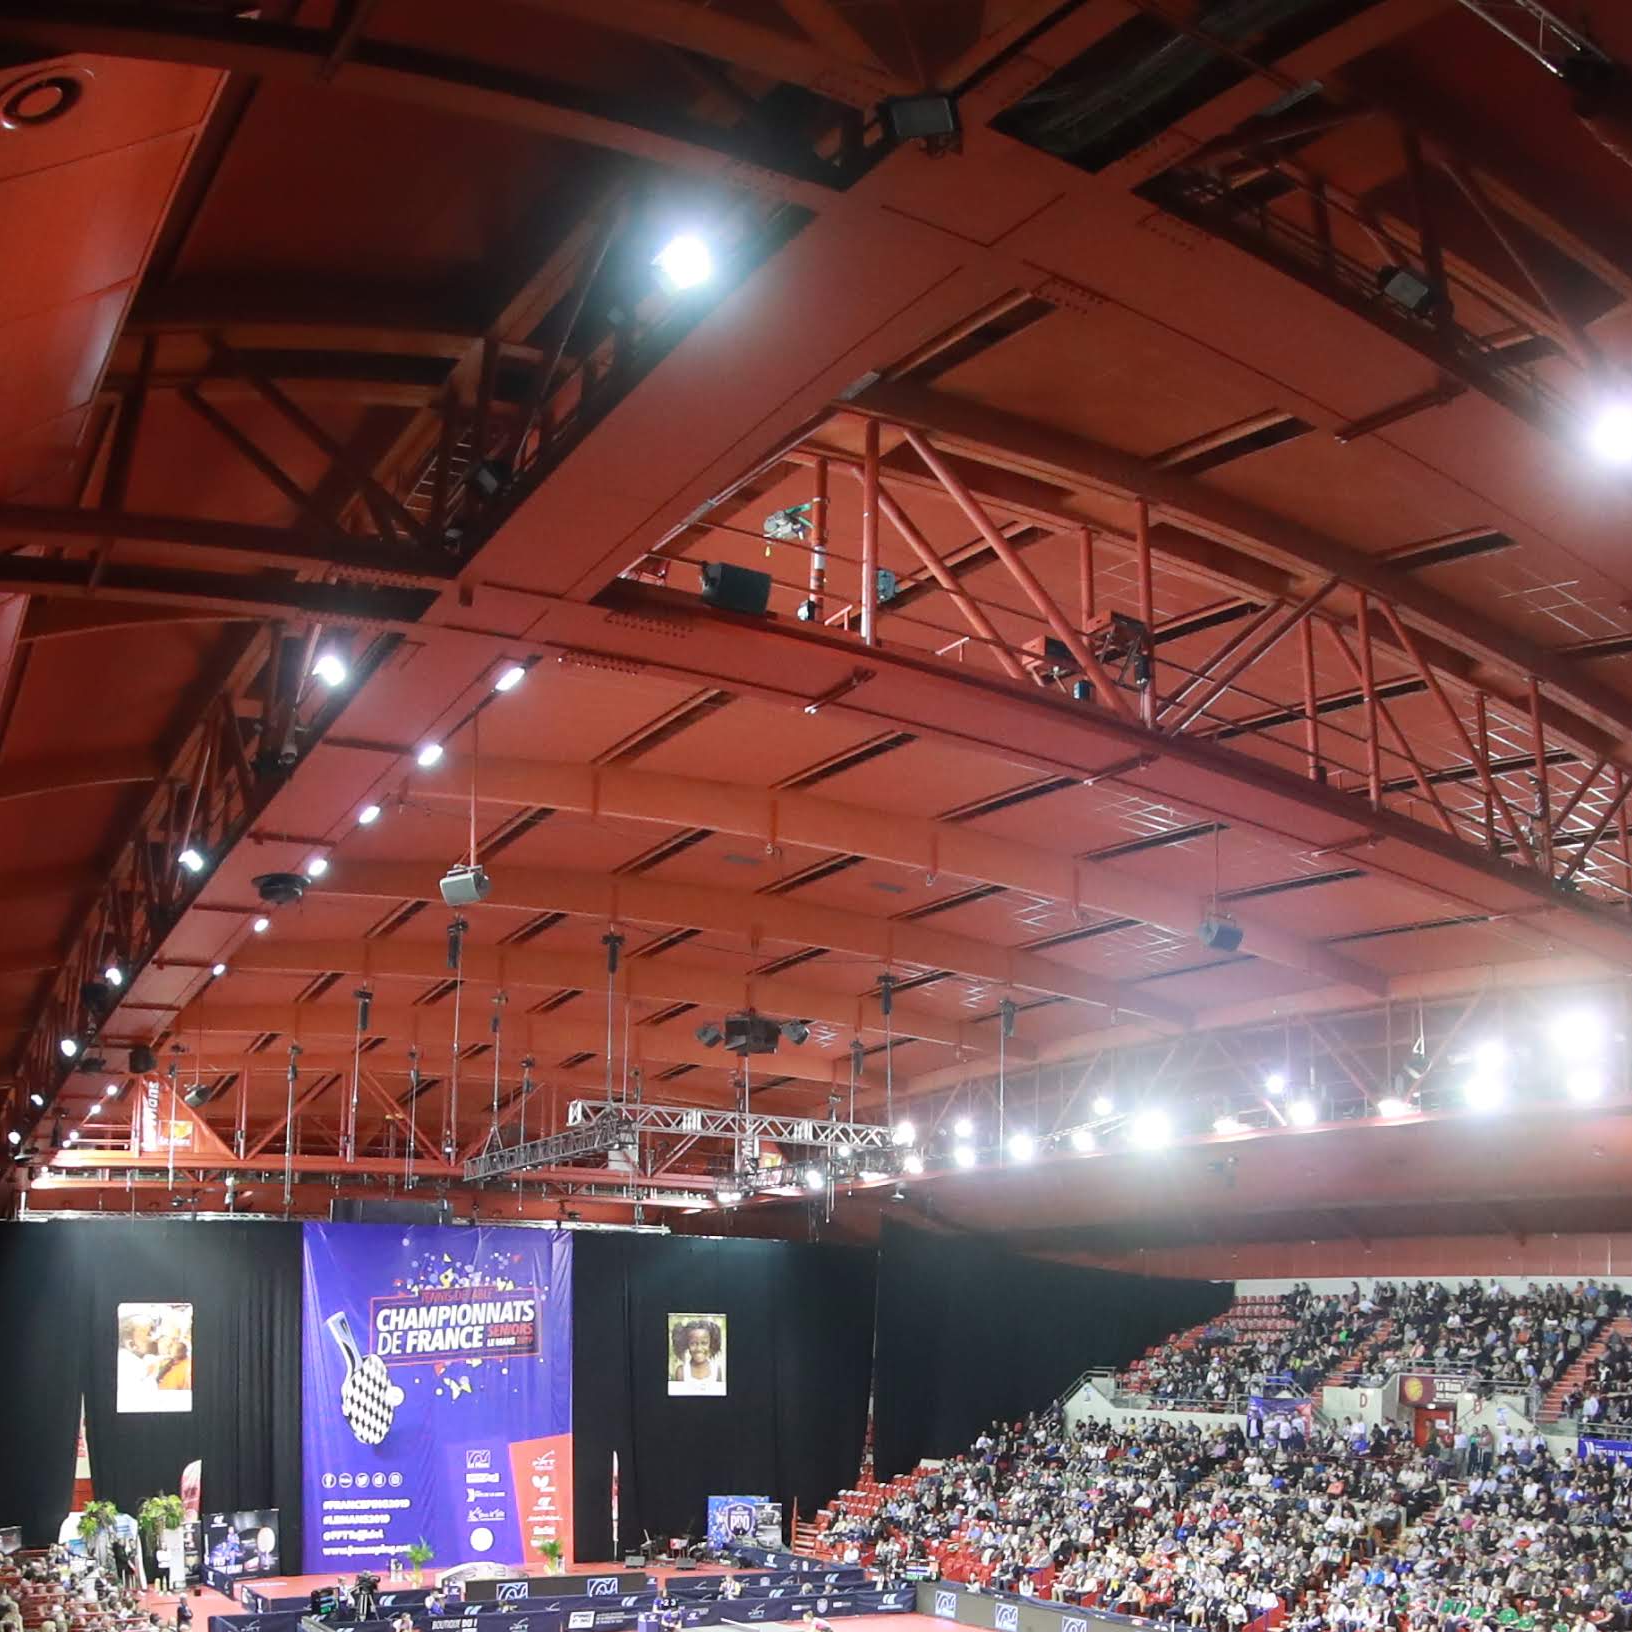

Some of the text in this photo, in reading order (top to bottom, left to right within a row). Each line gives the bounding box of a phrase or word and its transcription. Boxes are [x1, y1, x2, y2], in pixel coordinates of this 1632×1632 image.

[376, 1300, 535, 1331] CHAMPIONNATS
[377, 1326, 484, 1355] DE FRANCE
[1360, 1393, 1368, 1408] D
